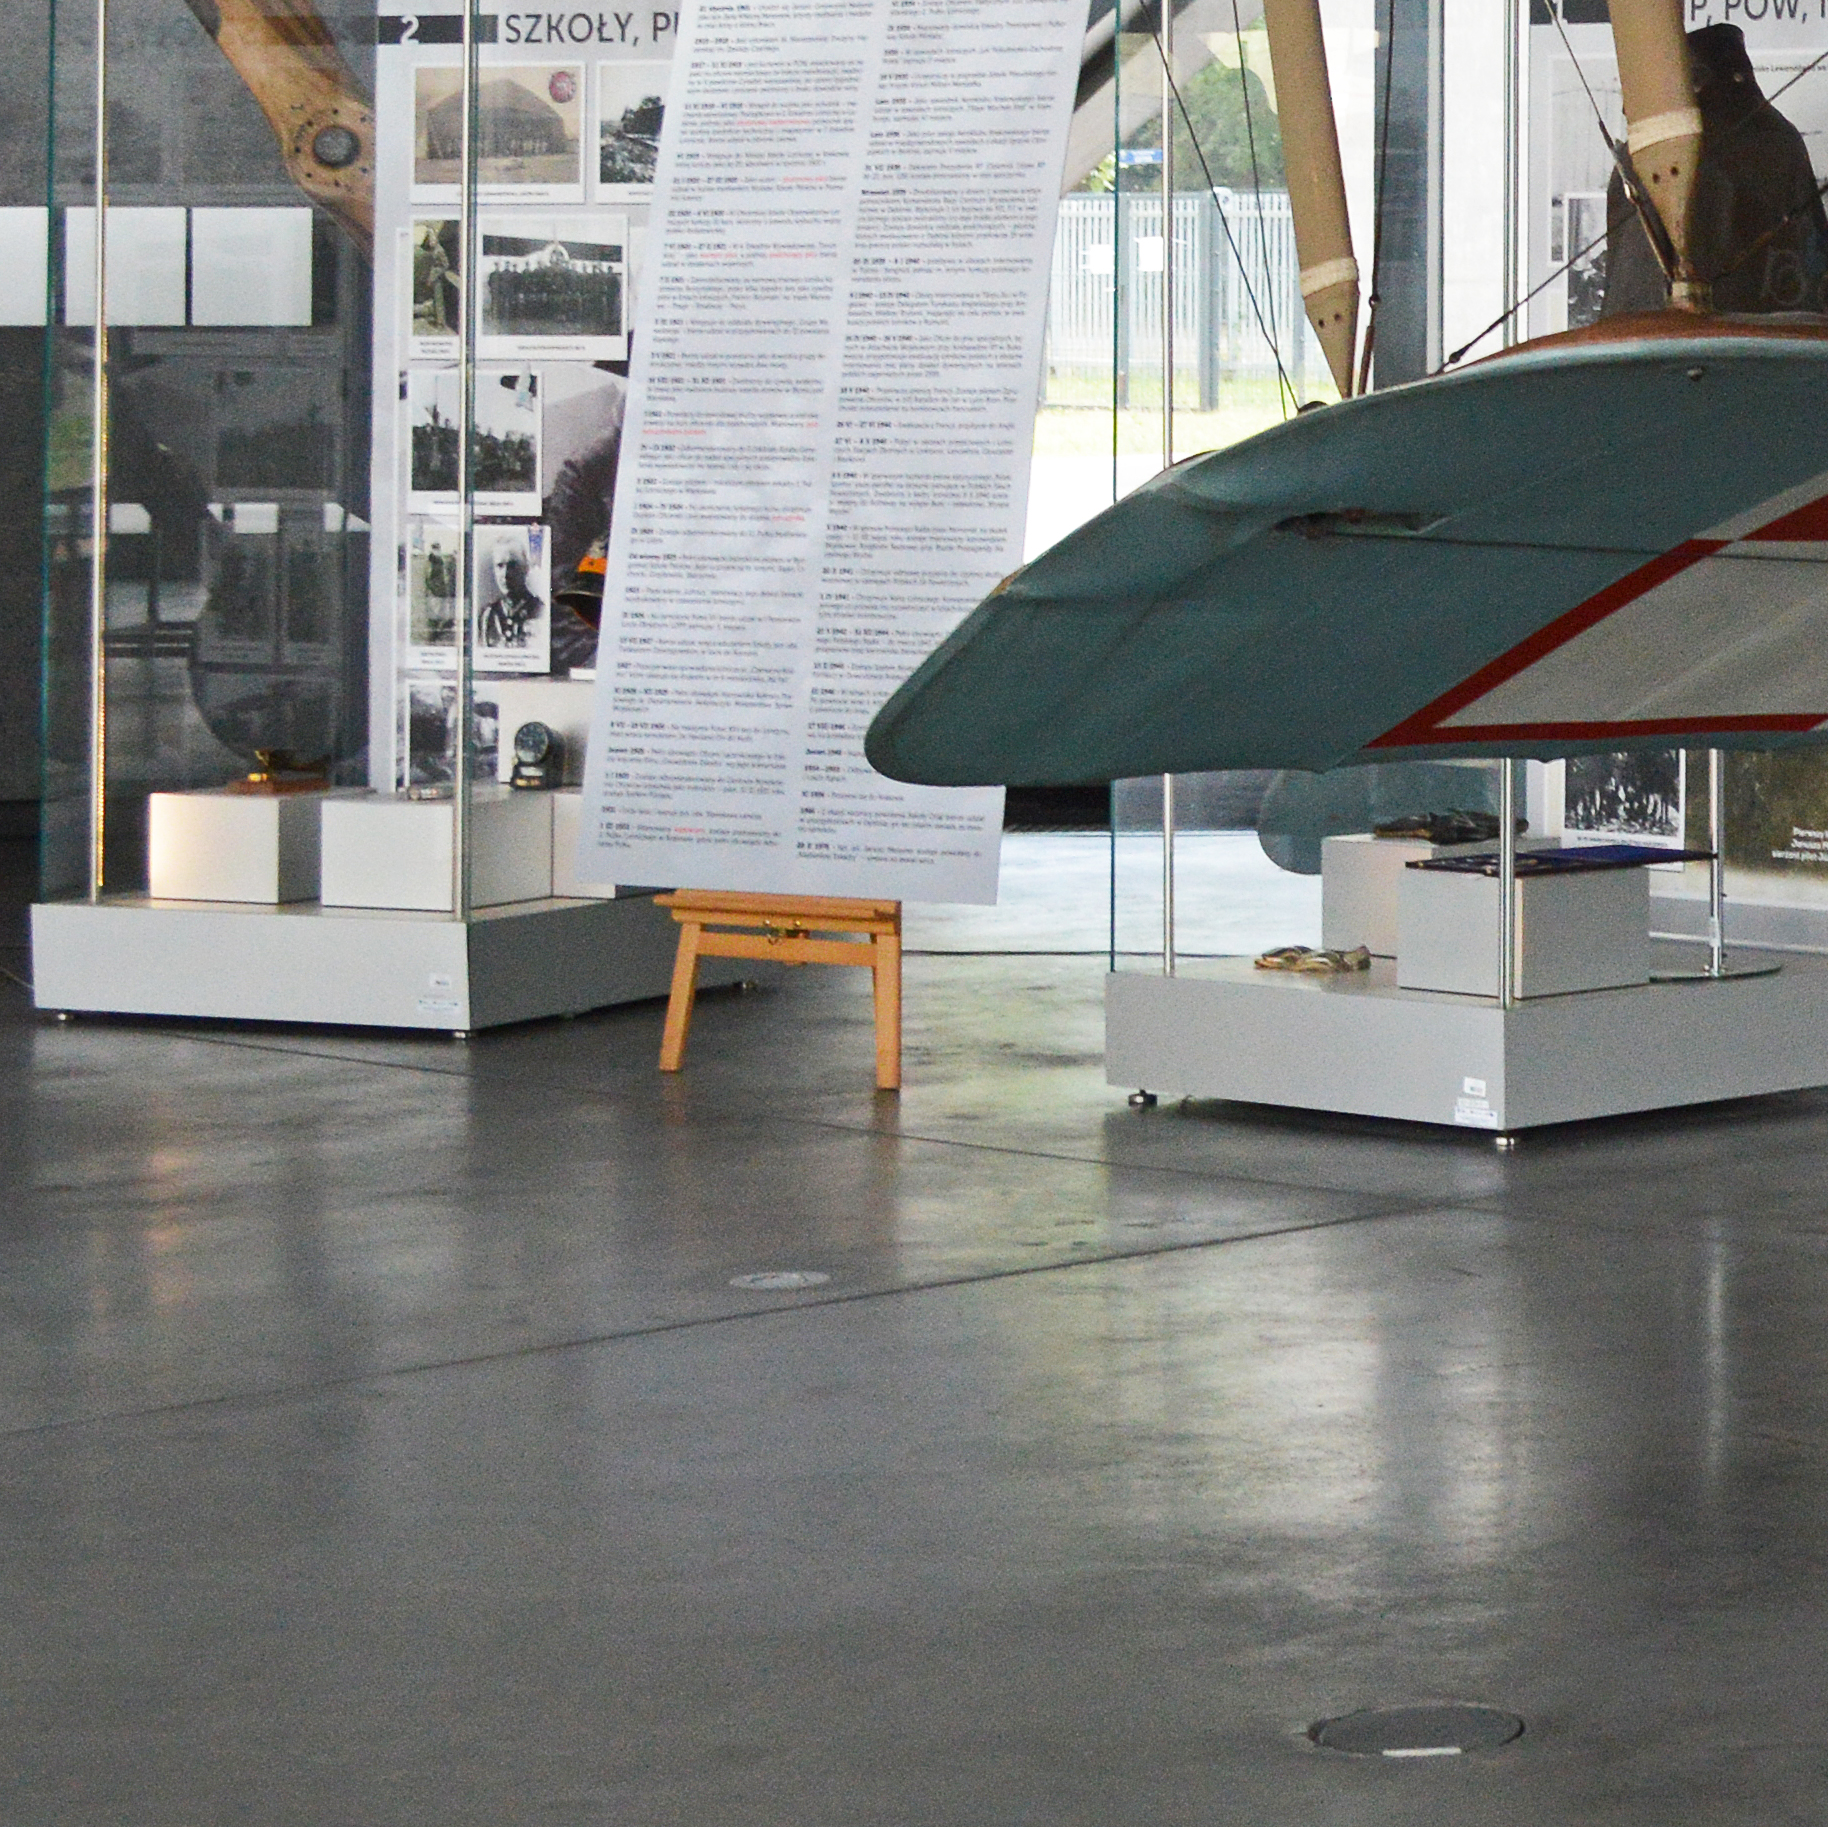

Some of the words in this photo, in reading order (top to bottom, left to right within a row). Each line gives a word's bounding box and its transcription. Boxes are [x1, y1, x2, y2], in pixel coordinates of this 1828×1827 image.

[401, 15, 420, 45] 2
[505, 12, 639, 46] SZKOŁY,
[652, 11, 679, 43] P
